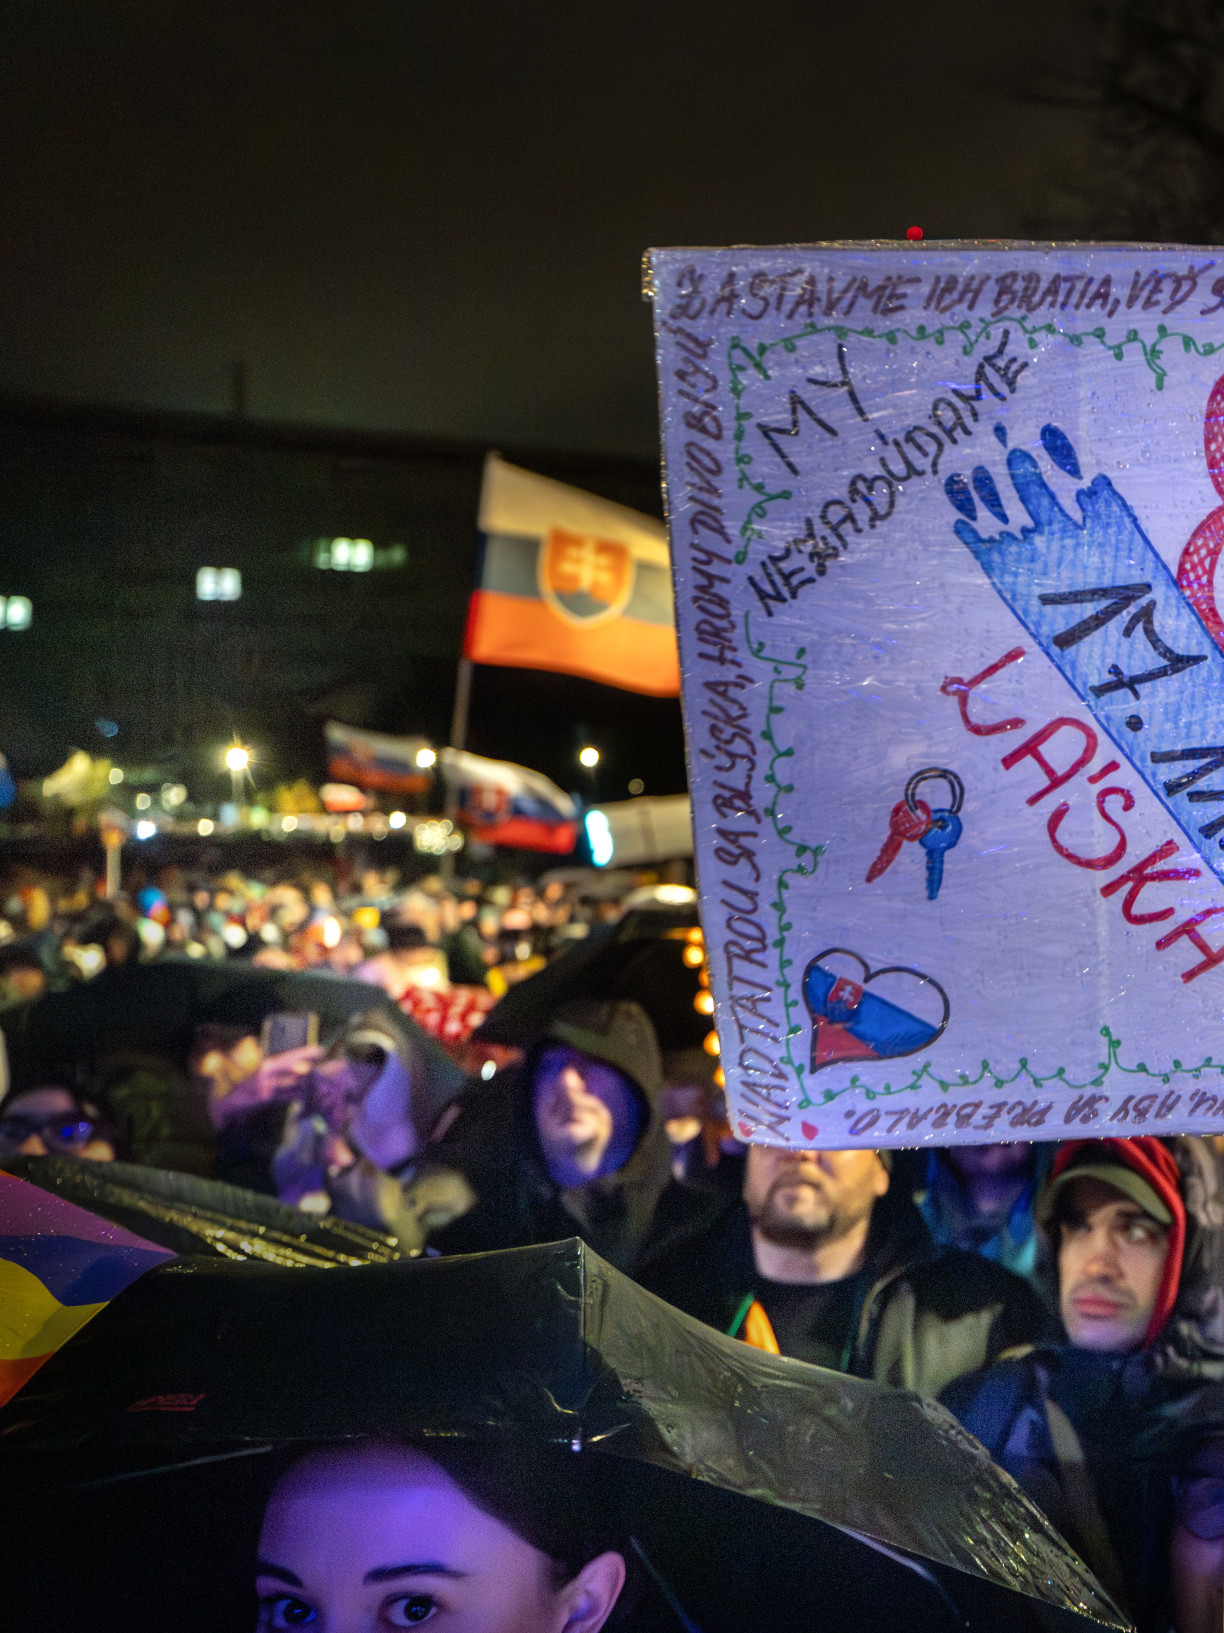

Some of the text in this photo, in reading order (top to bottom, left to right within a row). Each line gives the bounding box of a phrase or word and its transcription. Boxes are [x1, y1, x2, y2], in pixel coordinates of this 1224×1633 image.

[756, 343, 869, 477] MY
[685, 442, 732, 544] DIVO
[689, 541, 743, 668] HROMY
[713, 827, 761, 883] SA
[720, 879, 780, 1044] TATROU
[737, 1045, 791, 1141] NAD
